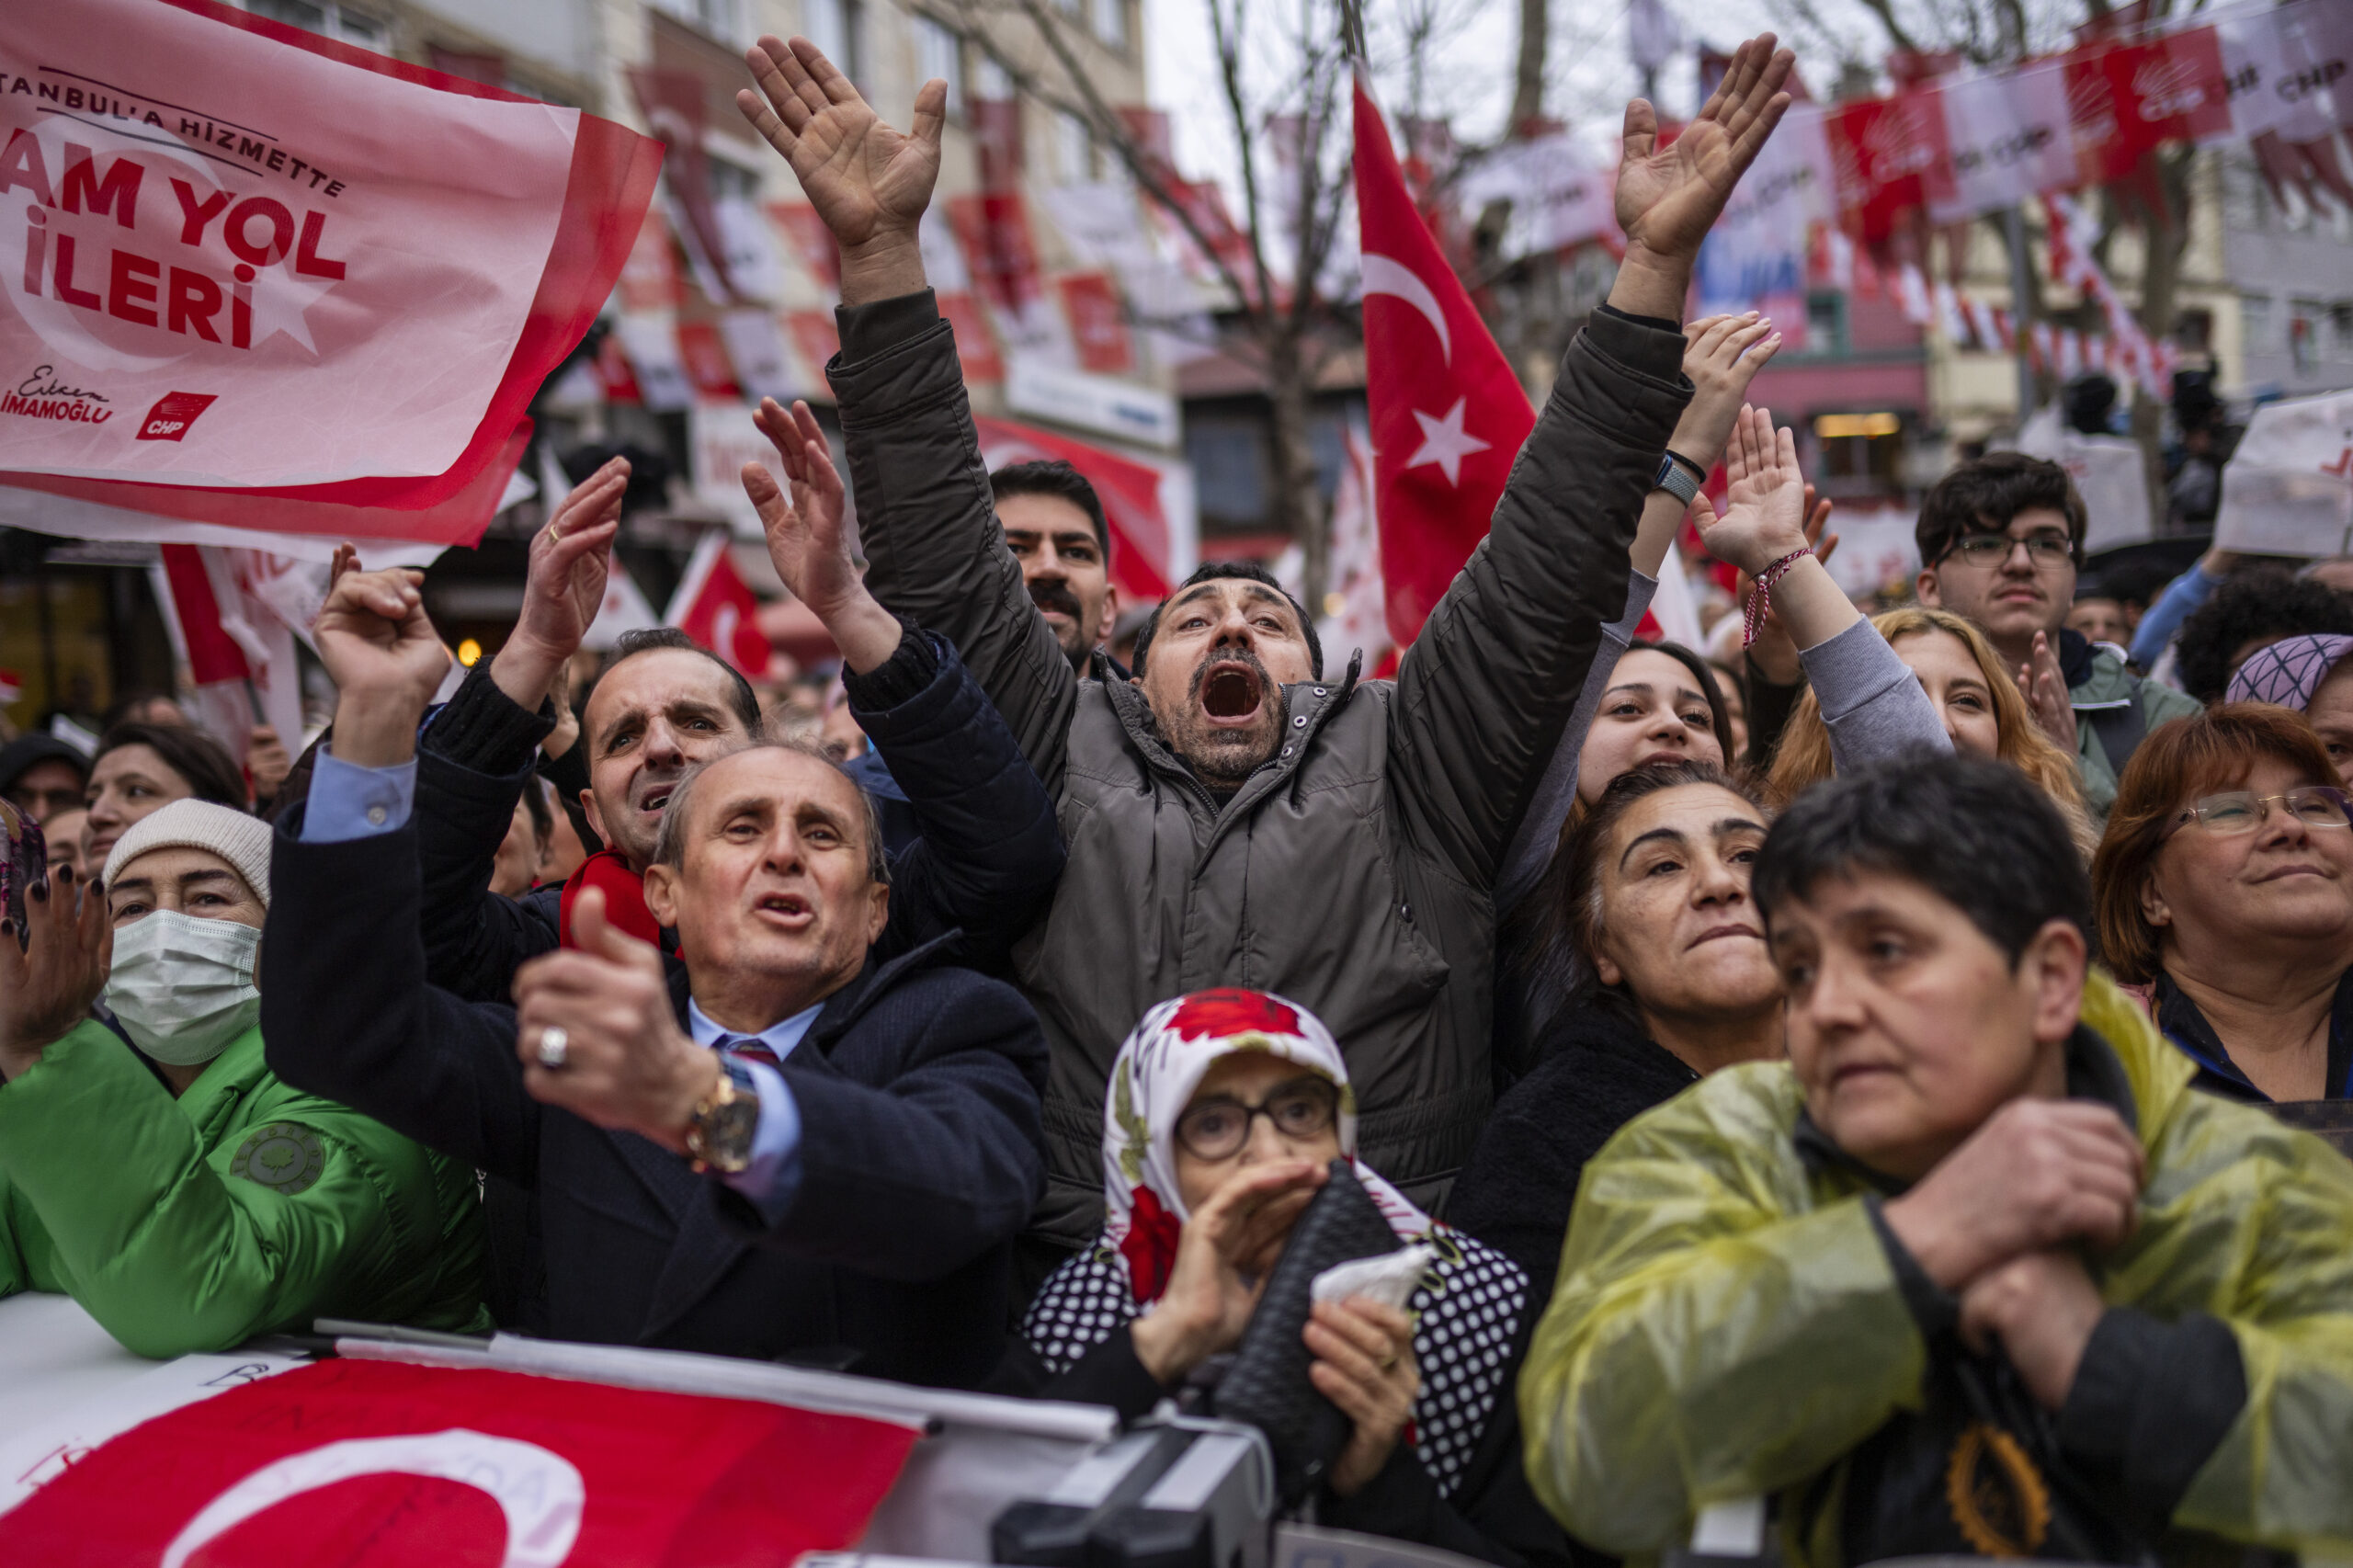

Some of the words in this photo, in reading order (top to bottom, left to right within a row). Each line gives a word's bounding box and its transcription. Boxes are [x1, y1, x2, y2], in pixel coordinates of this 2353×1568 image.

[180, 118, 346, 198] HİZMETTE
[0, 128, 144, 229] AM
[169, 176, 346, 280] YOL
[24, 204, 256, 350] İLERİ
[0, 391, 113, 424] İMAMOĞLU
[147, 420, 184, 435] CHP
